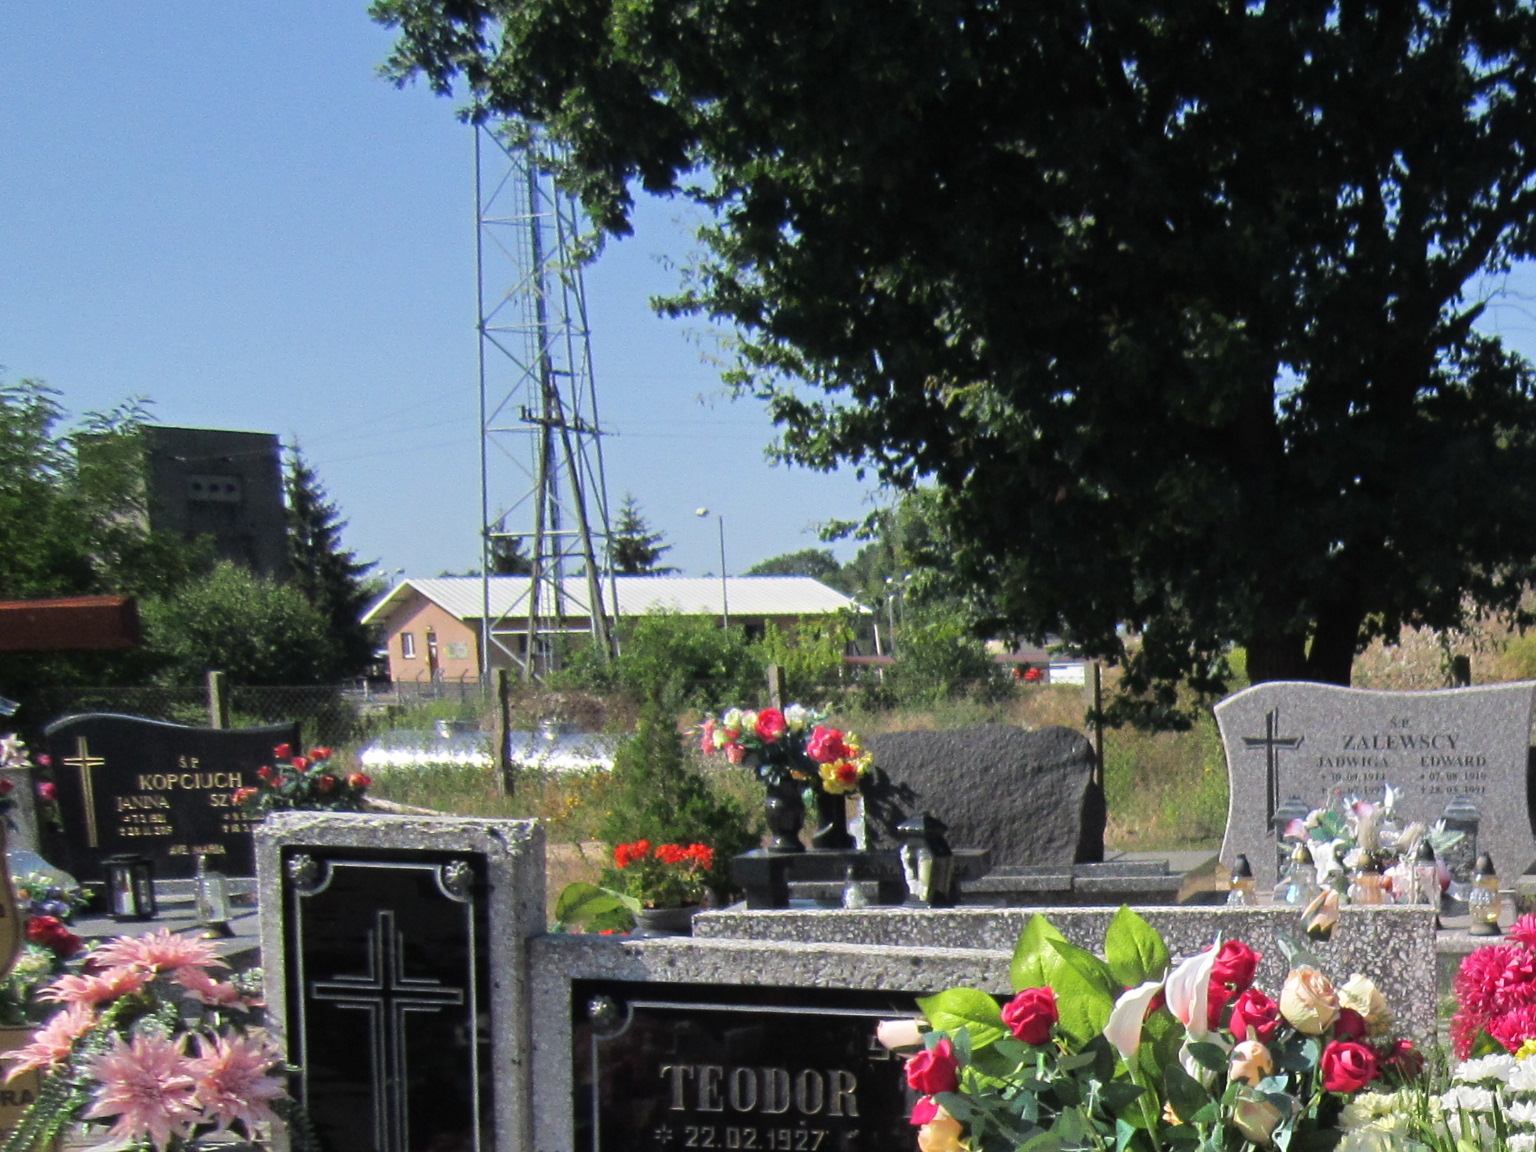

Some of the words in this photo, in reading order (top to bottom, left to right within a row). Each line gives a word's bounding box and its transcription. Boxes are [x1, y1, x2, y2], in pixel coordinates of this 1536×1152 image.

[1342, 733, 1461, 751] ZALEWSCY
[1315, 755, 1390, 769] JADWIGA
[1420, 755, 1488, 769] EDWARD
[138, 772, 243, 791] KOPCIUCH
[116, 795, 171, 812] JANINA
[659, 1063, 860, 1118] TEODOR
[684, 1124, 826, 1152] 22.02.1927
